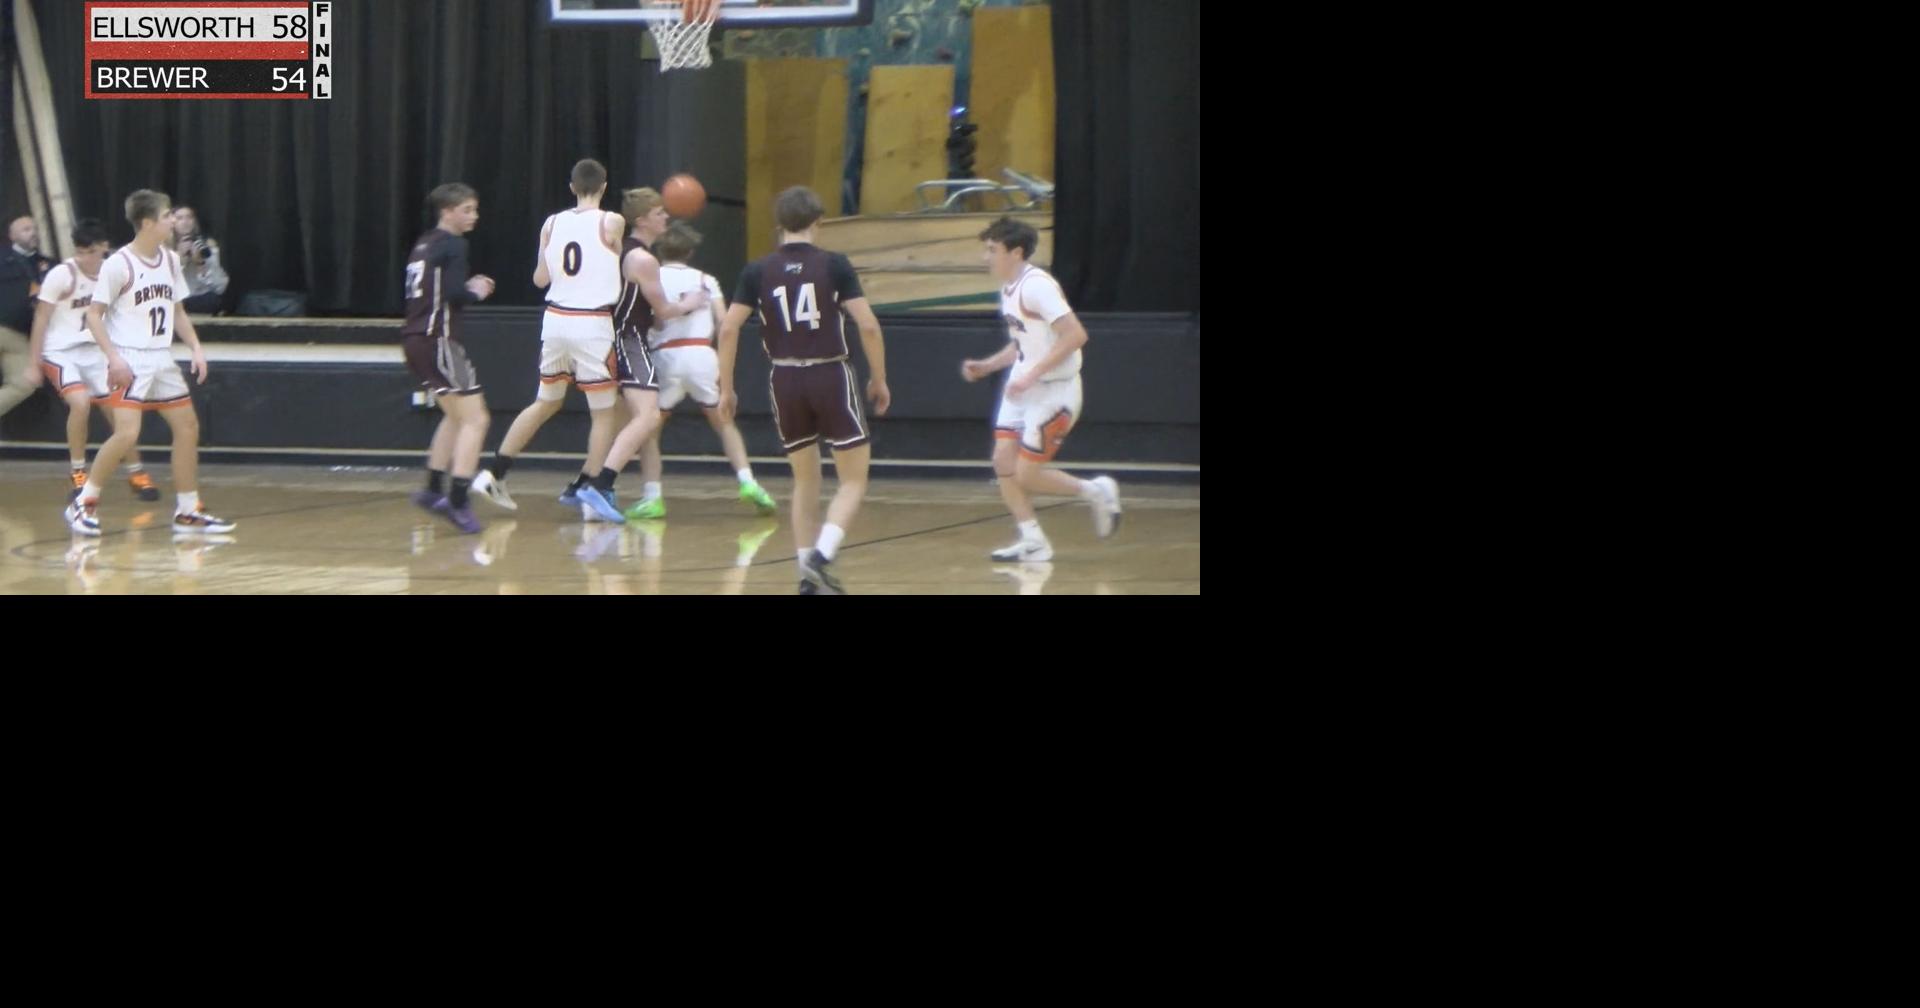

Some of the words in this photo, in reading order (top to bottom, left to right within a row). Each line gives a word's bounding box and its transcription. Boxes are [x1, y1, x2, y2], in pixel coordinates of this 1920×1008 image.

[563, 240, 582, 277] 0
[149, 306, 166, 337] 12
[773, 282, 821, 332] 14
